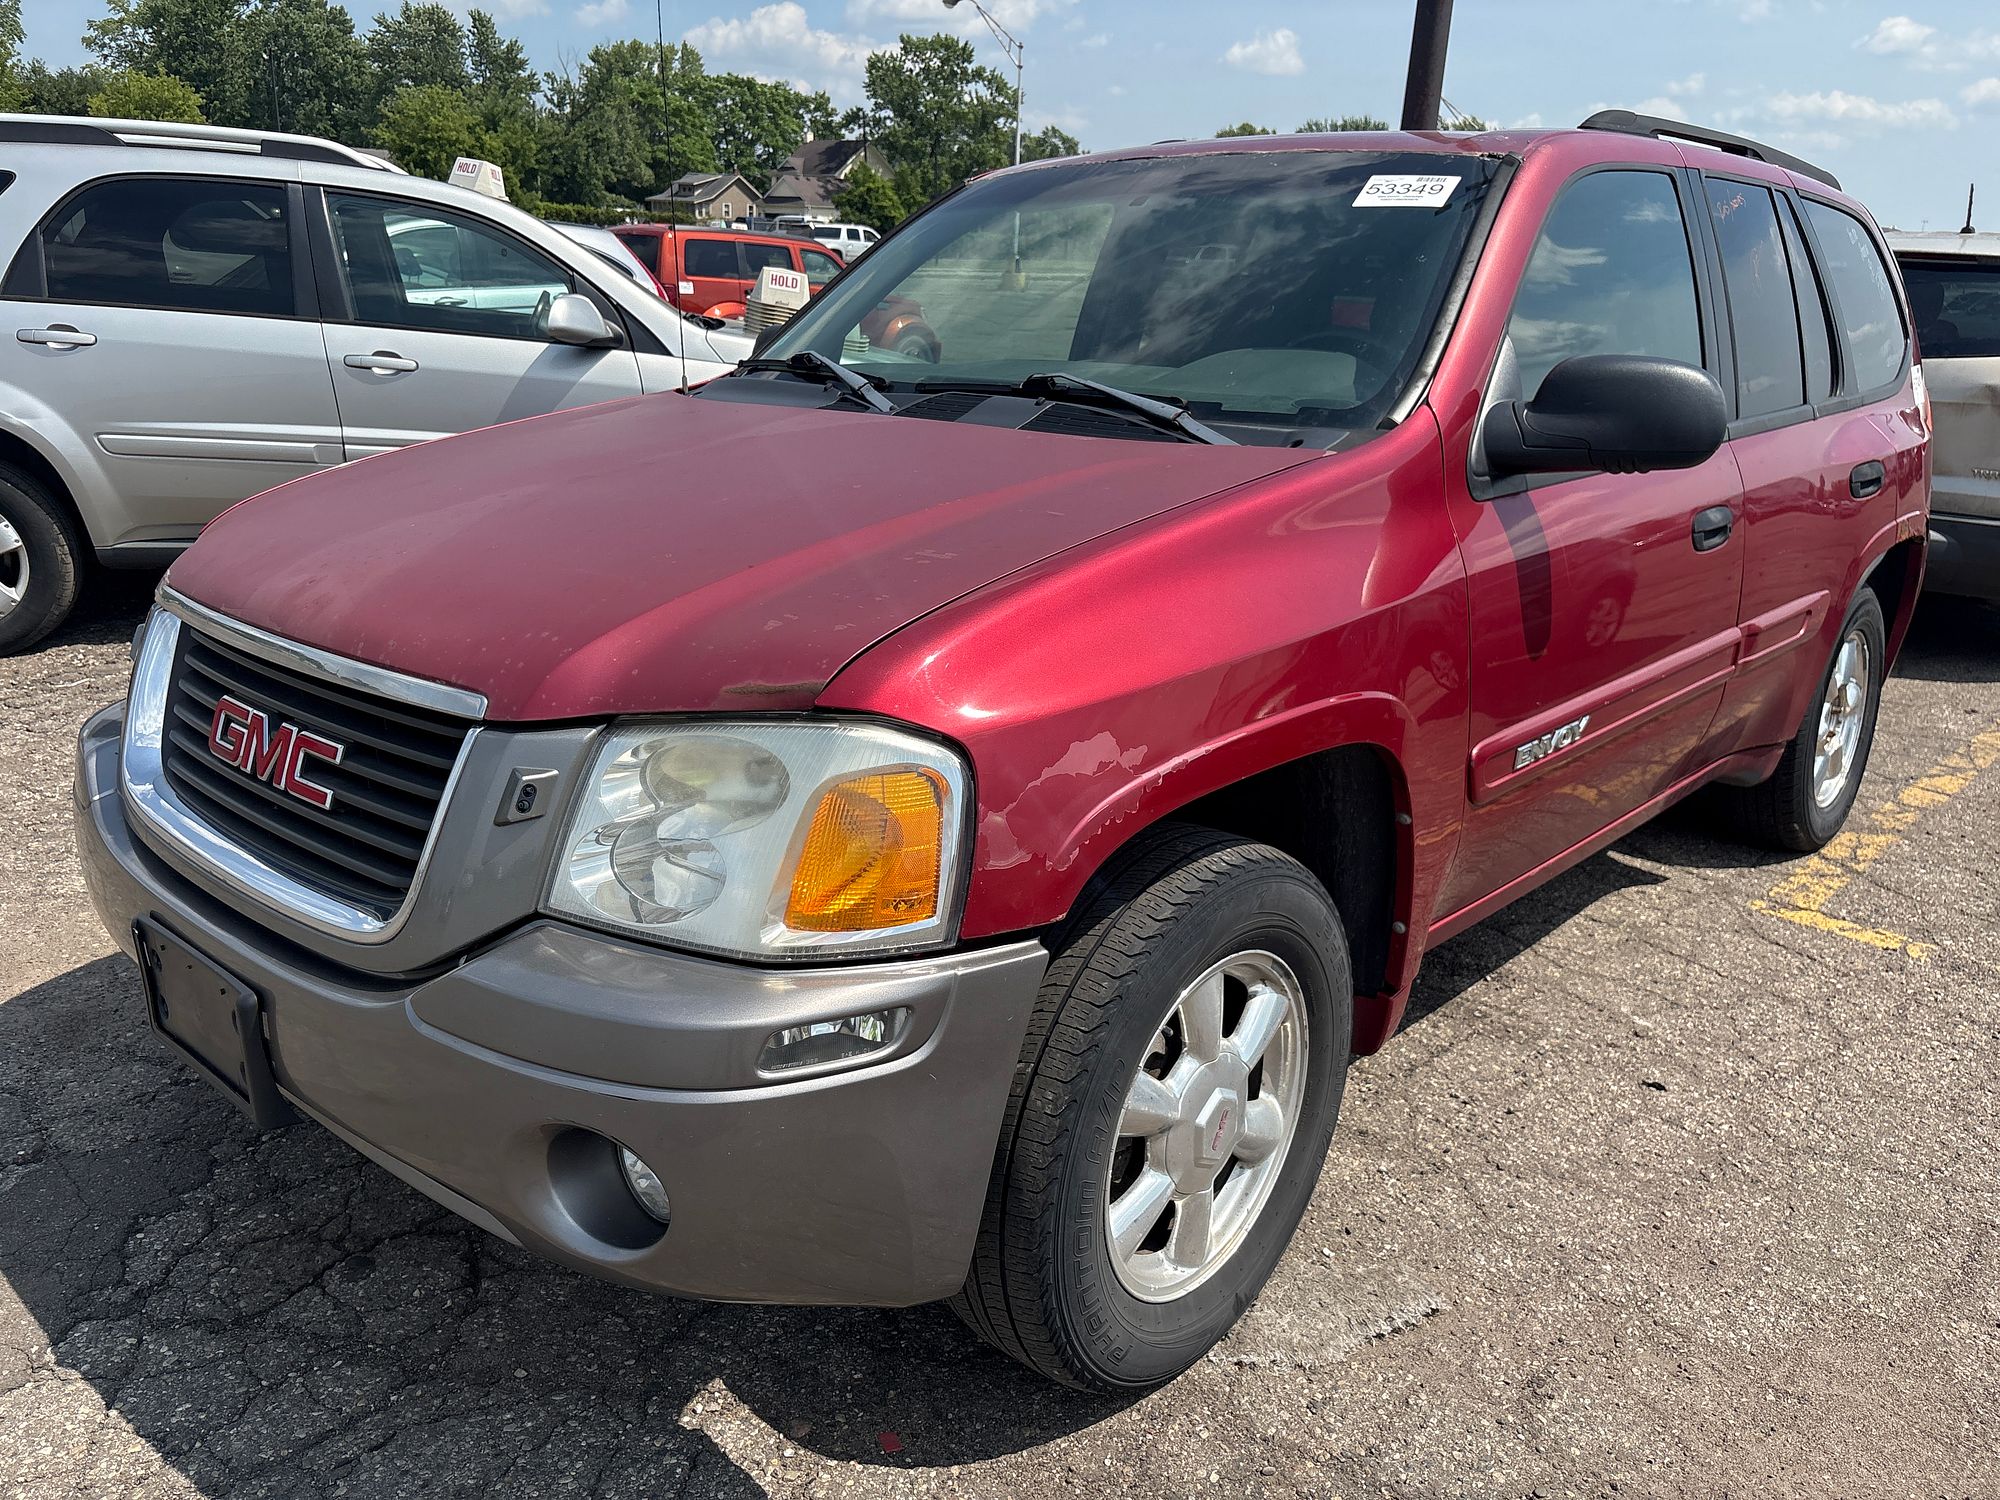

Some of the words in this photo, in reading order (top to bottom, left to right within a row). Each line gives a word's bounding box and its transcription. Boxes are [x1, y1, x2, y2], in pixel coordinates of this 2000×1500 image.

[457, 161, 477, 174] HOLD
[1366, 183, 1444, 195] 53349
[770, 274, 798, 289] HOLD
[208, 695, 344, 811] GMC
[1514, 715, 1590, 770] ENVOY
[1073, 1179, 1134, 1367] PHANTOM
